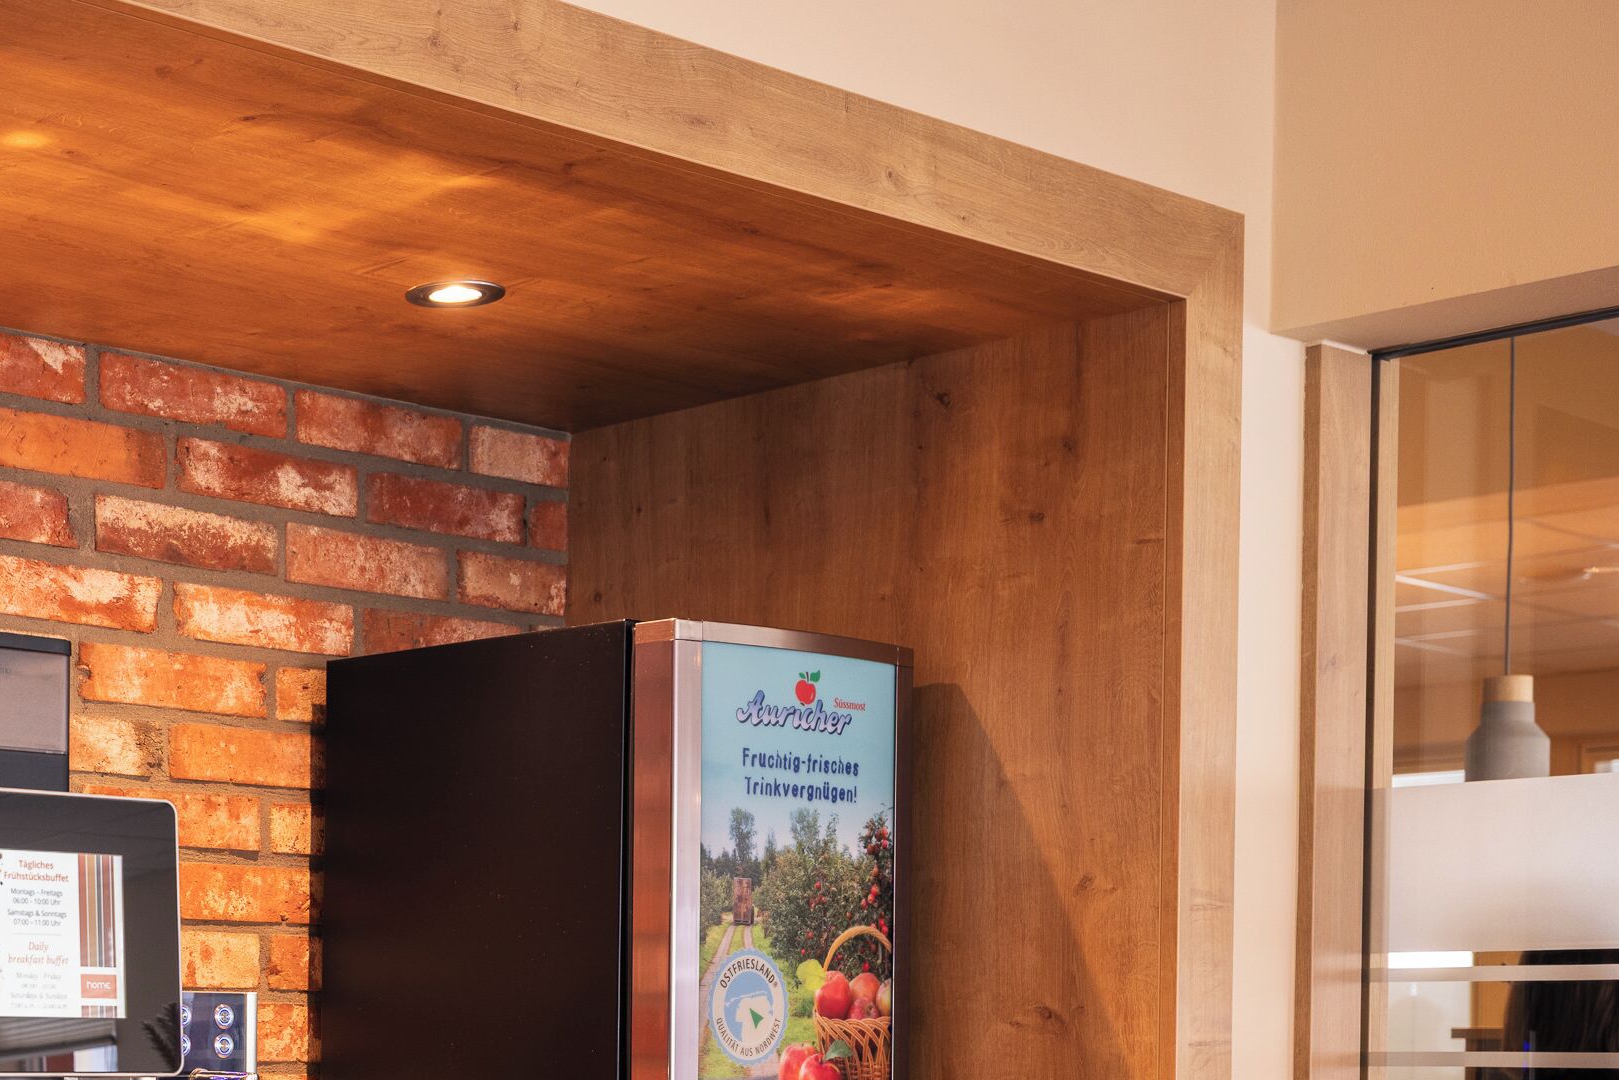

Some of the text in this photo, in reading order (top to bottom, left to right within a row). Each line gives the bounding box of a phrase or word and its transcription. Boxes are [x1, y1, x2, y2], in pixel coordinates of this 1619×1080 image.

[834, 697, 866, 711] Süssmost
[736, 690, 852, 735] Auricher
[742, 747, 859, 776] Fruchtig-frisches
[745, 776, 857, 803] Trinkvergnügen!
[19, 859, 53, 870] Tägliches
[4, 871, 69, 882] Frühstücksbuffet
[10, 888, 35, 896] Montags
[41, 889, 62, 897] Freitags
[7, 909, 34, 917] Samstags
[41, 910, 67, 919] Sonntags
[28, 941, 49, 952] Daily
[8, 954, 68, 966] breakfast buffet
[716, 1017, 781, 1056] QUALITÄT AUS NORDWEST
